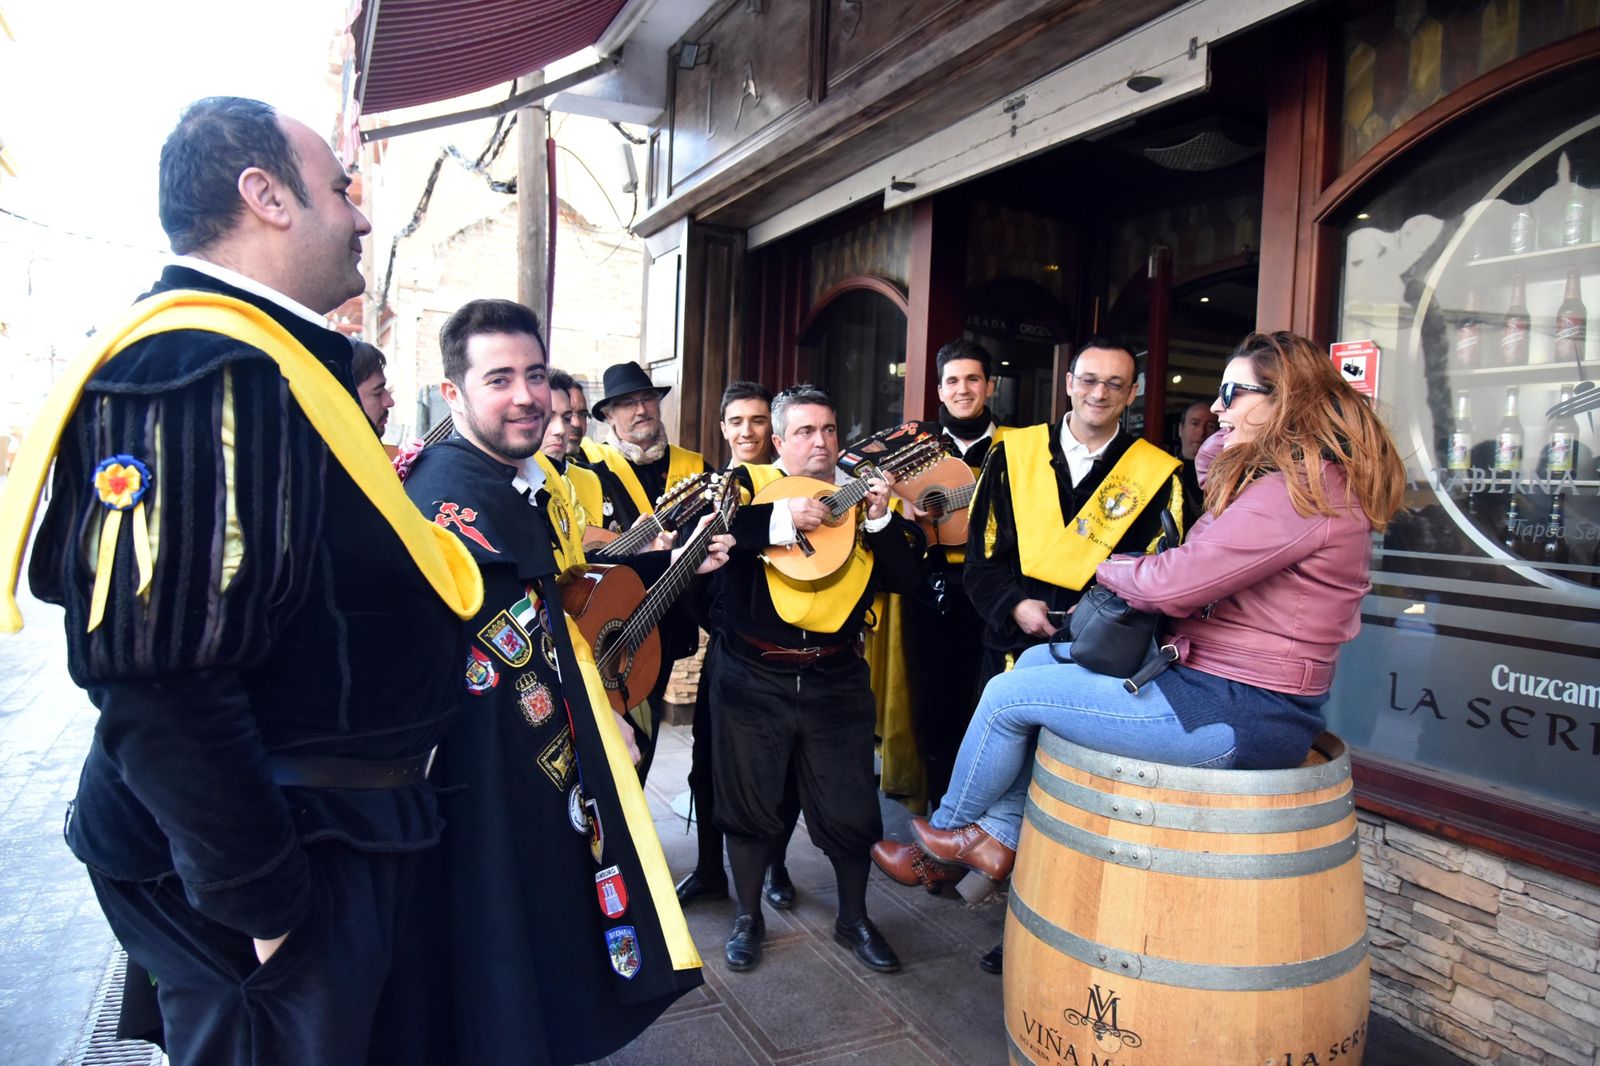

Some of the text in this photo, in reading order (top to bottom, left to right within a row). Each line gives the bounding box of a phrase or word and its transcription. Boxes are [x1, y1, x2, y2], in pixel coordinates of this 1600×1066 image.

[1430, 466, 1580, 496] TABERNA
[1388, 671, 1447, 720] LA
[1022, 1010, 1079, 1066] VIÑA
